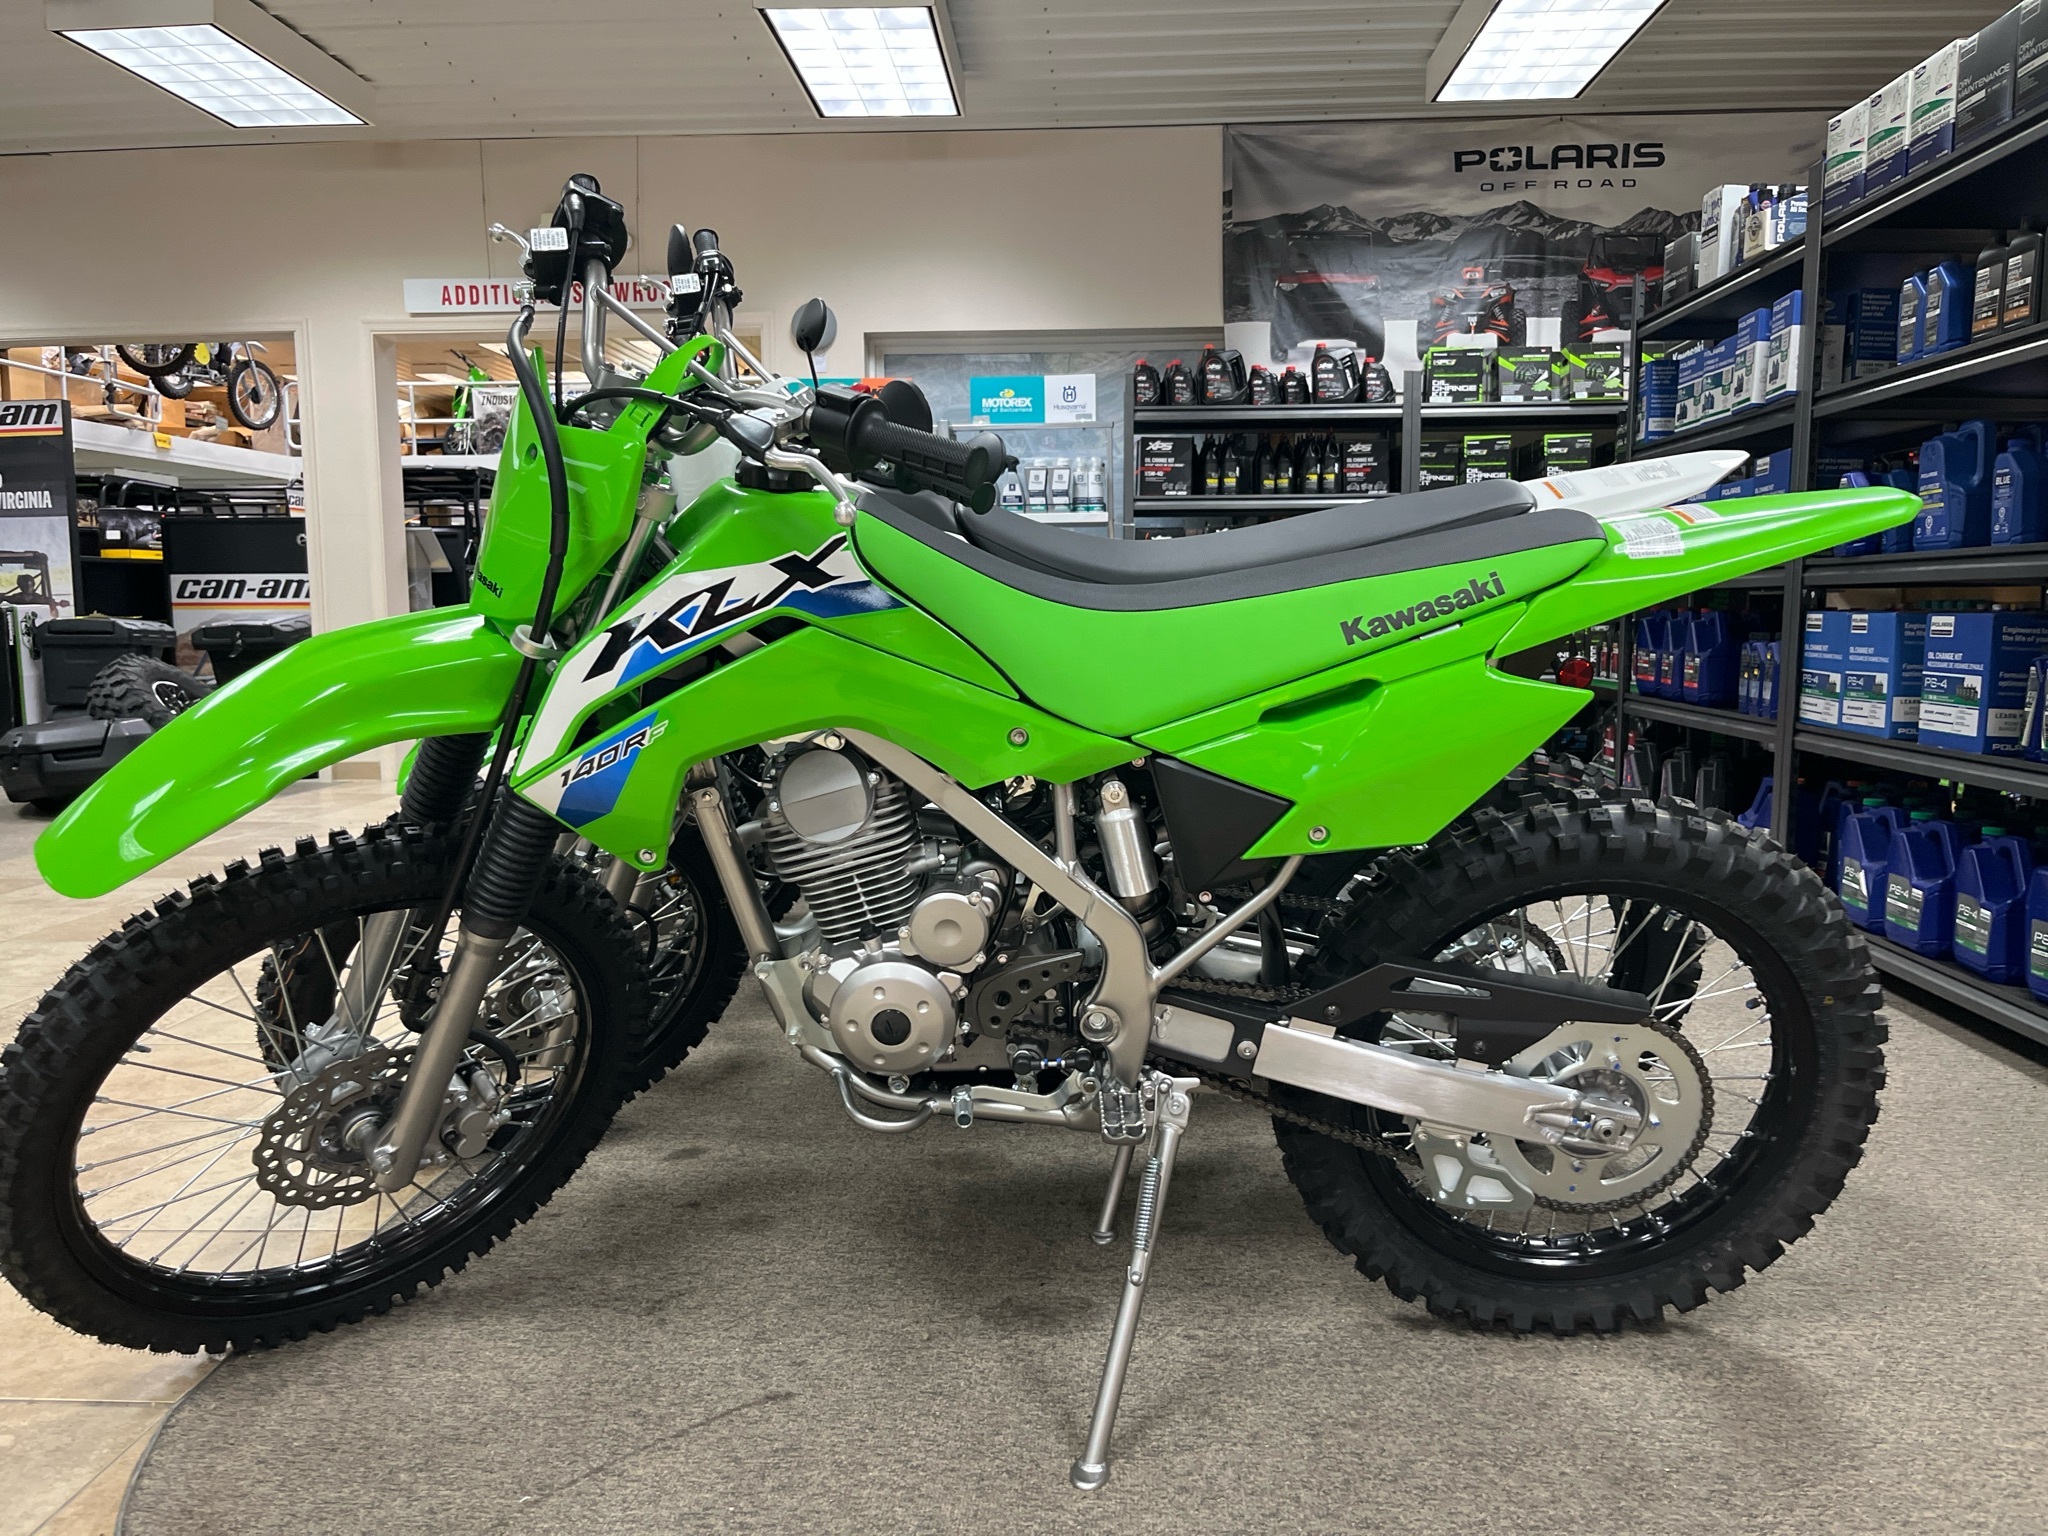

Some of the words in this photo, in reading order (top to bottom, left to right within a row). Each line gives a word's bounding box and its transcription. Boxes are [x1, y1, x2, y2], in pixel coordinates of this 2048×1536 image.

[1454, 142, 1666, 173] POLARIS
[1480, 180, 1537, 192] OFF
[1554, 178, 1637, 190] ROAD
[441, 284, 546, 306] ADDITI
[481, 394, 516, 407] INDUST
[982, 397, 1033, 408] MOTOREX
[1053, 403, 1087, 411] Husqvarna
[1146, 440, 1174, 451] XPS
[1347, 442, 1373, 452] XPS
[1995, 475, 2011, 486] BLUE
[176, 579, 310, 599] can-am
[582, 533, 849, 683] KLX
[1340, 571, 1506, 646] Kawasaki
[1927, 651, 1935, 659] OIL
[1935, 652, 1954, 660] CHANGE
[1802, 673, 1819, 684] PS-4
[1847, 676, 1864, 686] PS-4
[1924, 677, 1948, 689] PS-4
[1888, 883, 1910, 899] PS-4
[1957, 903, 1979, 919] PS-4
